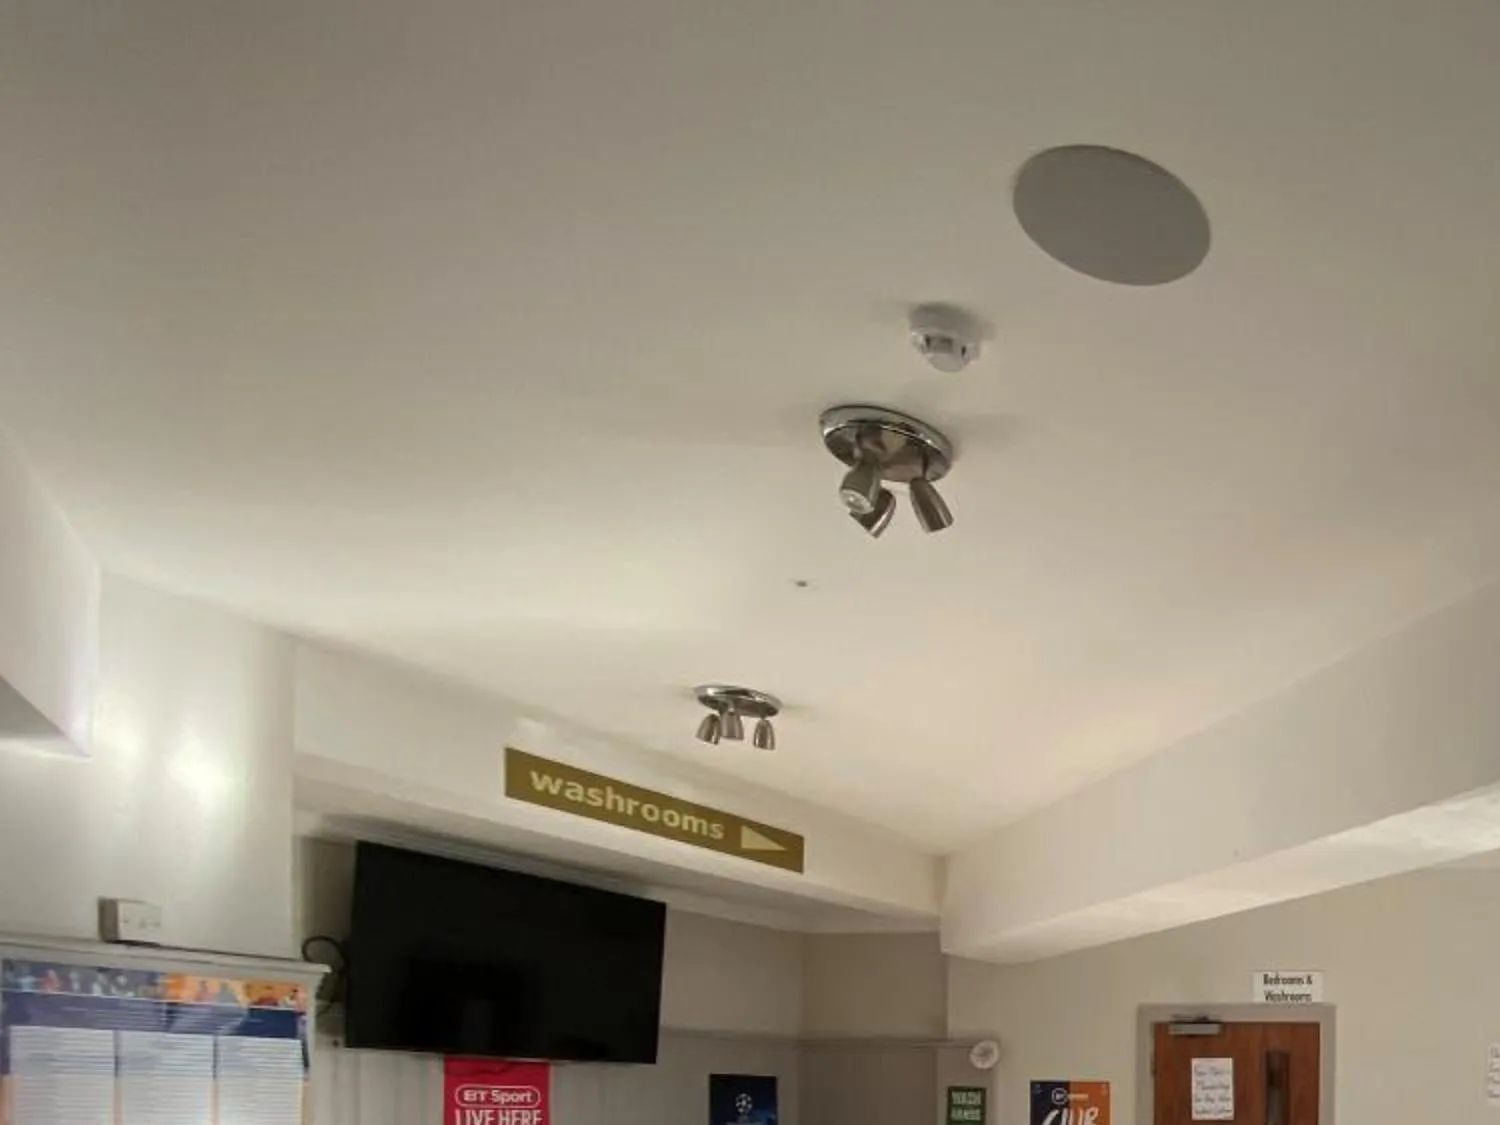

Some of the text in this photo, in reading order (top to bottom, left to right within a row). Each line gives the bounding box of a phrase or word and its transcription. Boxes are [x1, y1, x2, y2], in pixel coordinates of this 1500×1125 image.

[529, 769, 724, 840] washrooms
[464, 1089, 532, 1104] BT Sport
